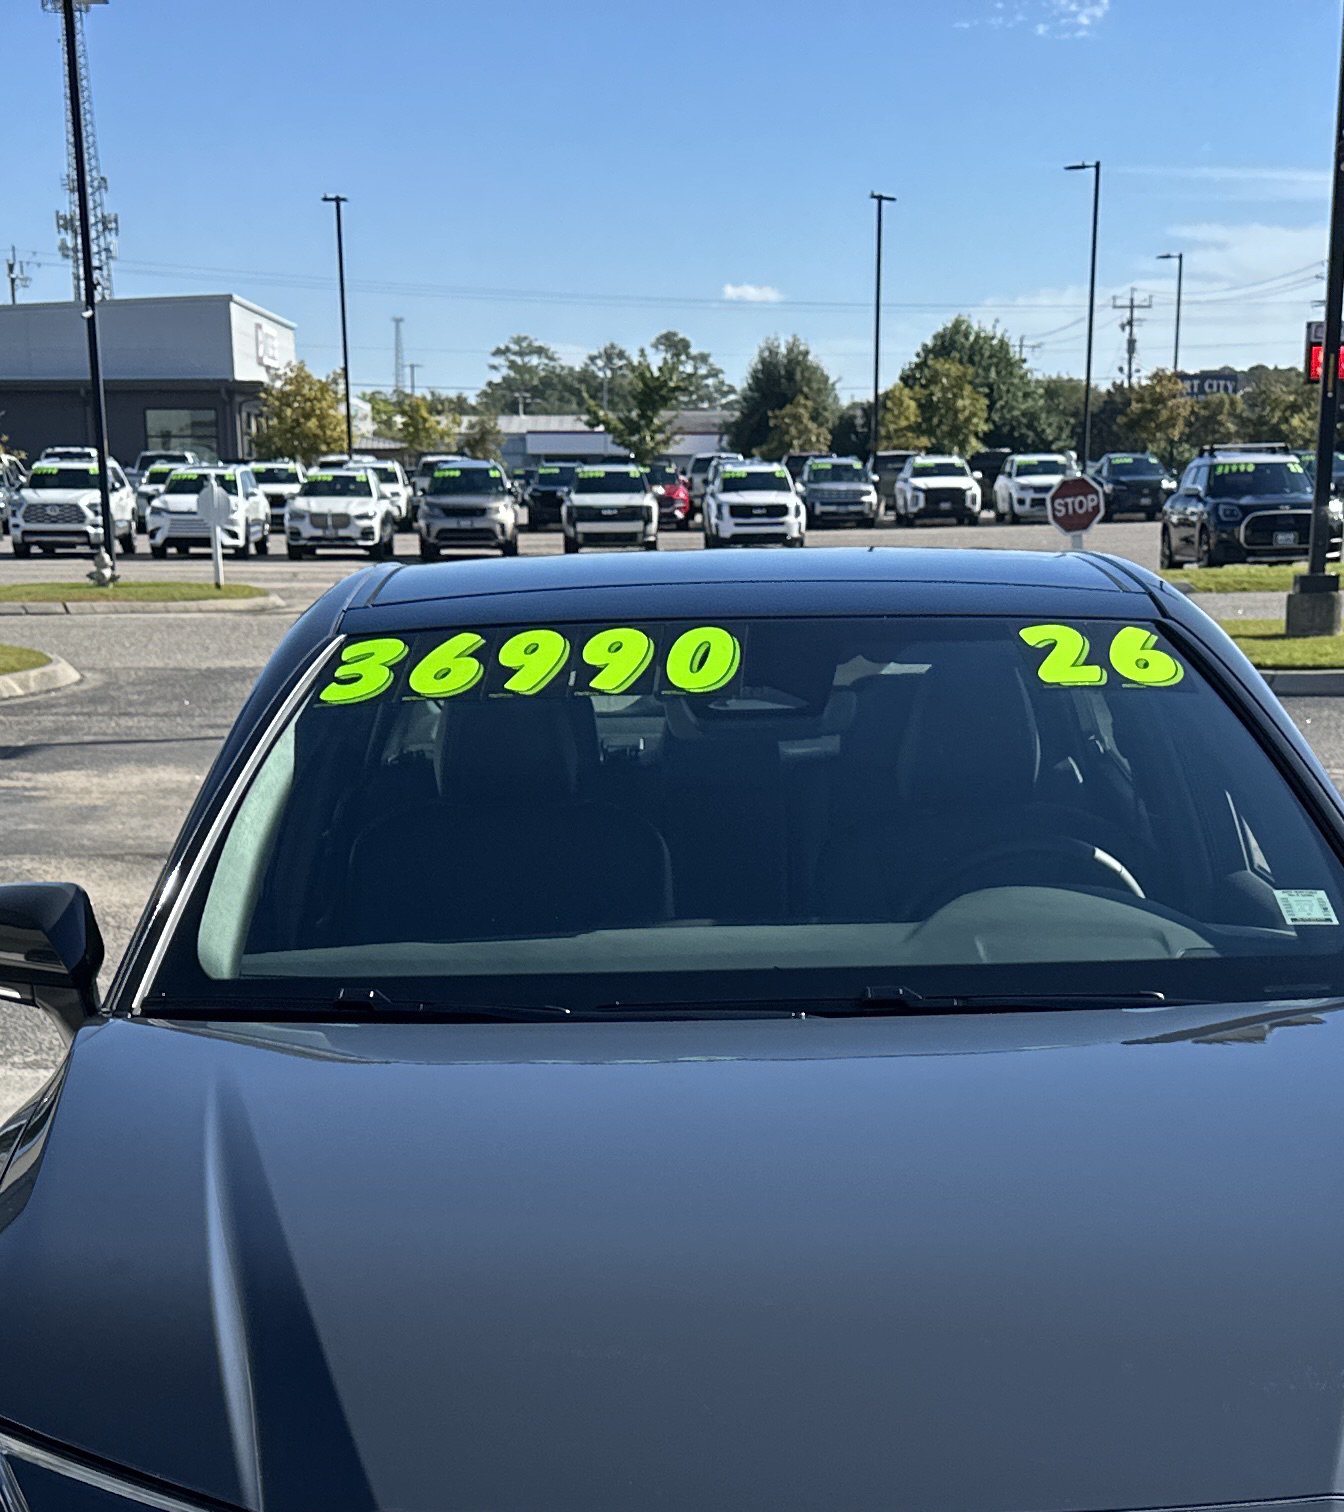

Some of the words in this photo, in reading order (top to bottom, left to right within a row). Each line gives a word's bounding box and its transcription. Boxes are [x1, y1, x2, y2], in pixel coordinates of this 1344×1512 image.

[1054, 494, 1098, 517] STOP
[319, 626, 741, 705] 36990
[1018, 624, 1185, 688] 26
